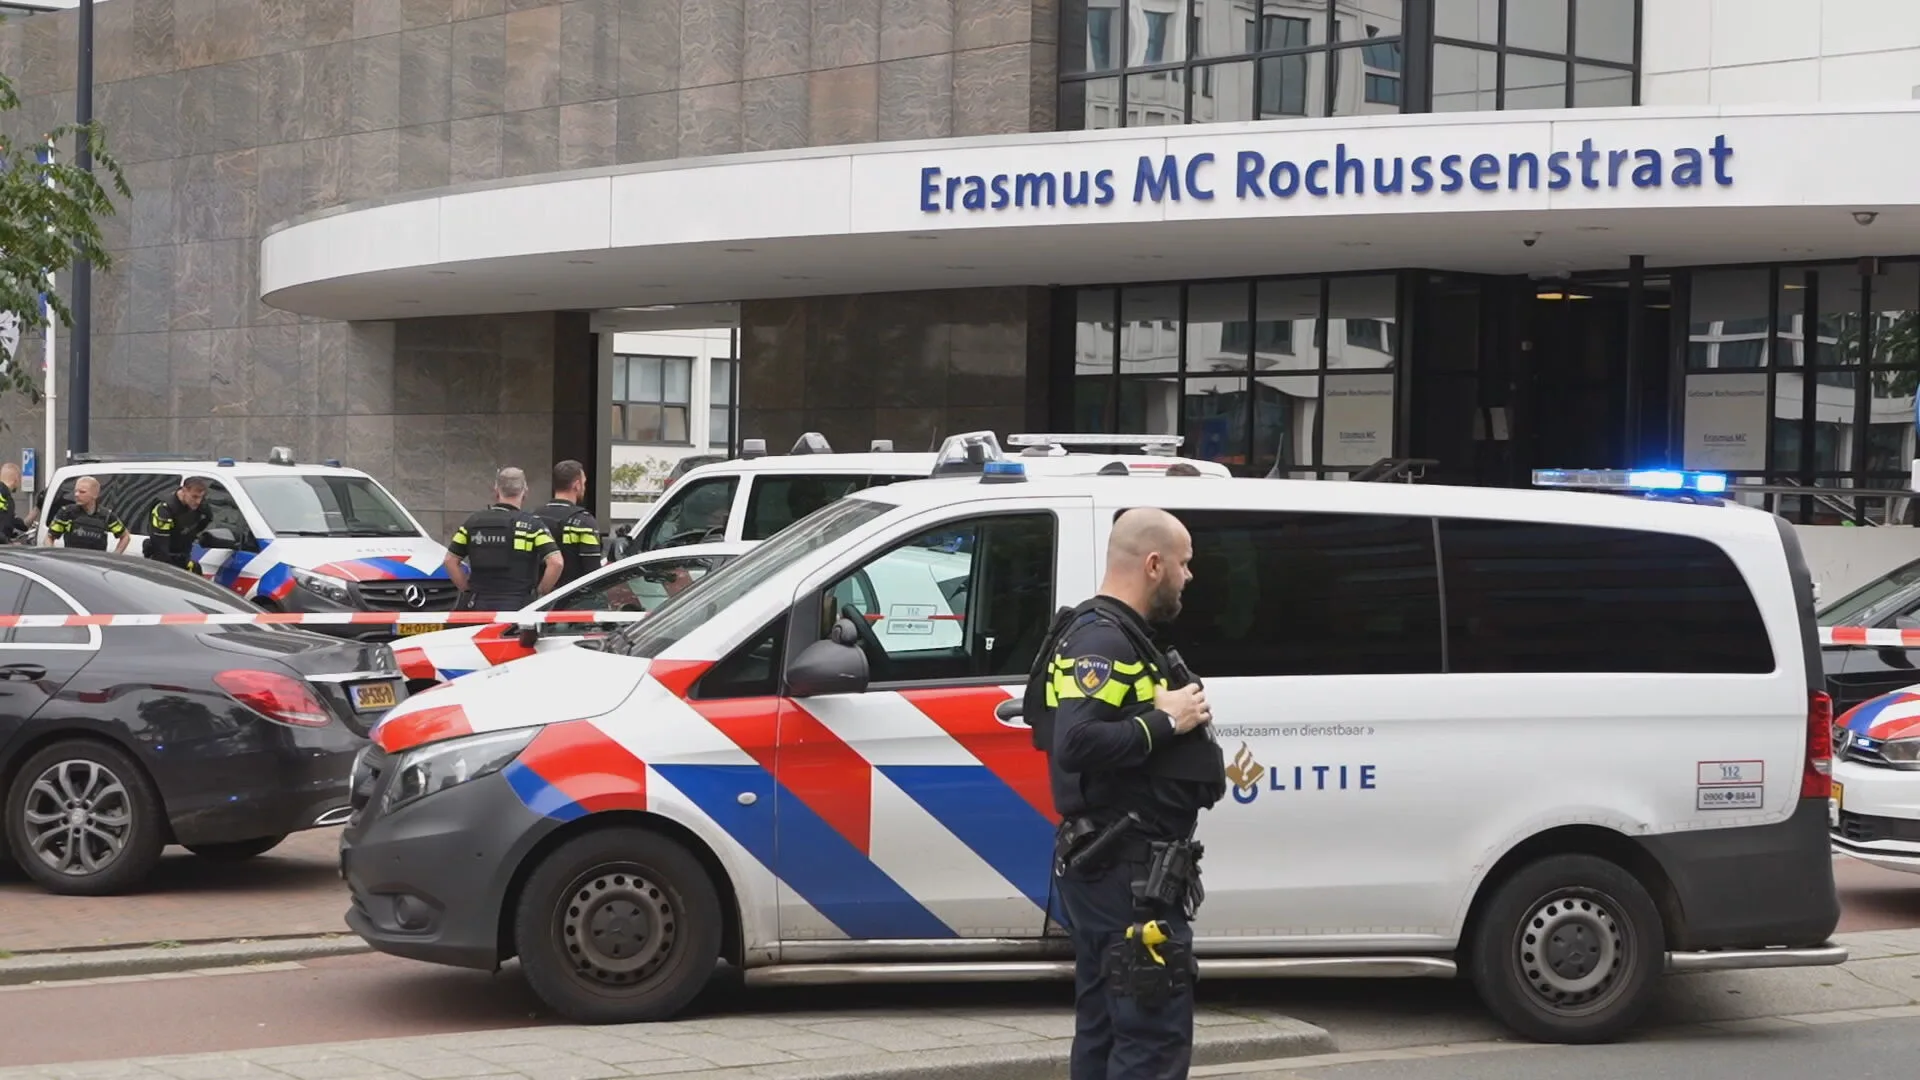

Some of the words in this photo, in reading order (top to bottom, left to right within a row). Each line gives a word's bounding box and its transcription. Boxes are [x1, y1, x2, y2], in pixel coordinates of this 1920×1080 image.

[920, 166, 1115, 212] Erasmus
[1133, 153, 1215, 203] MC
[1236, 134, 1734, 199] Rochussenstraat
[1215, 726, 1280, 737] waakzaam
[1282, 727, 1298, 736] en
[1300, 724, 1365, 736] dienstbaar
[1722, 765, 1740, 777] 112
